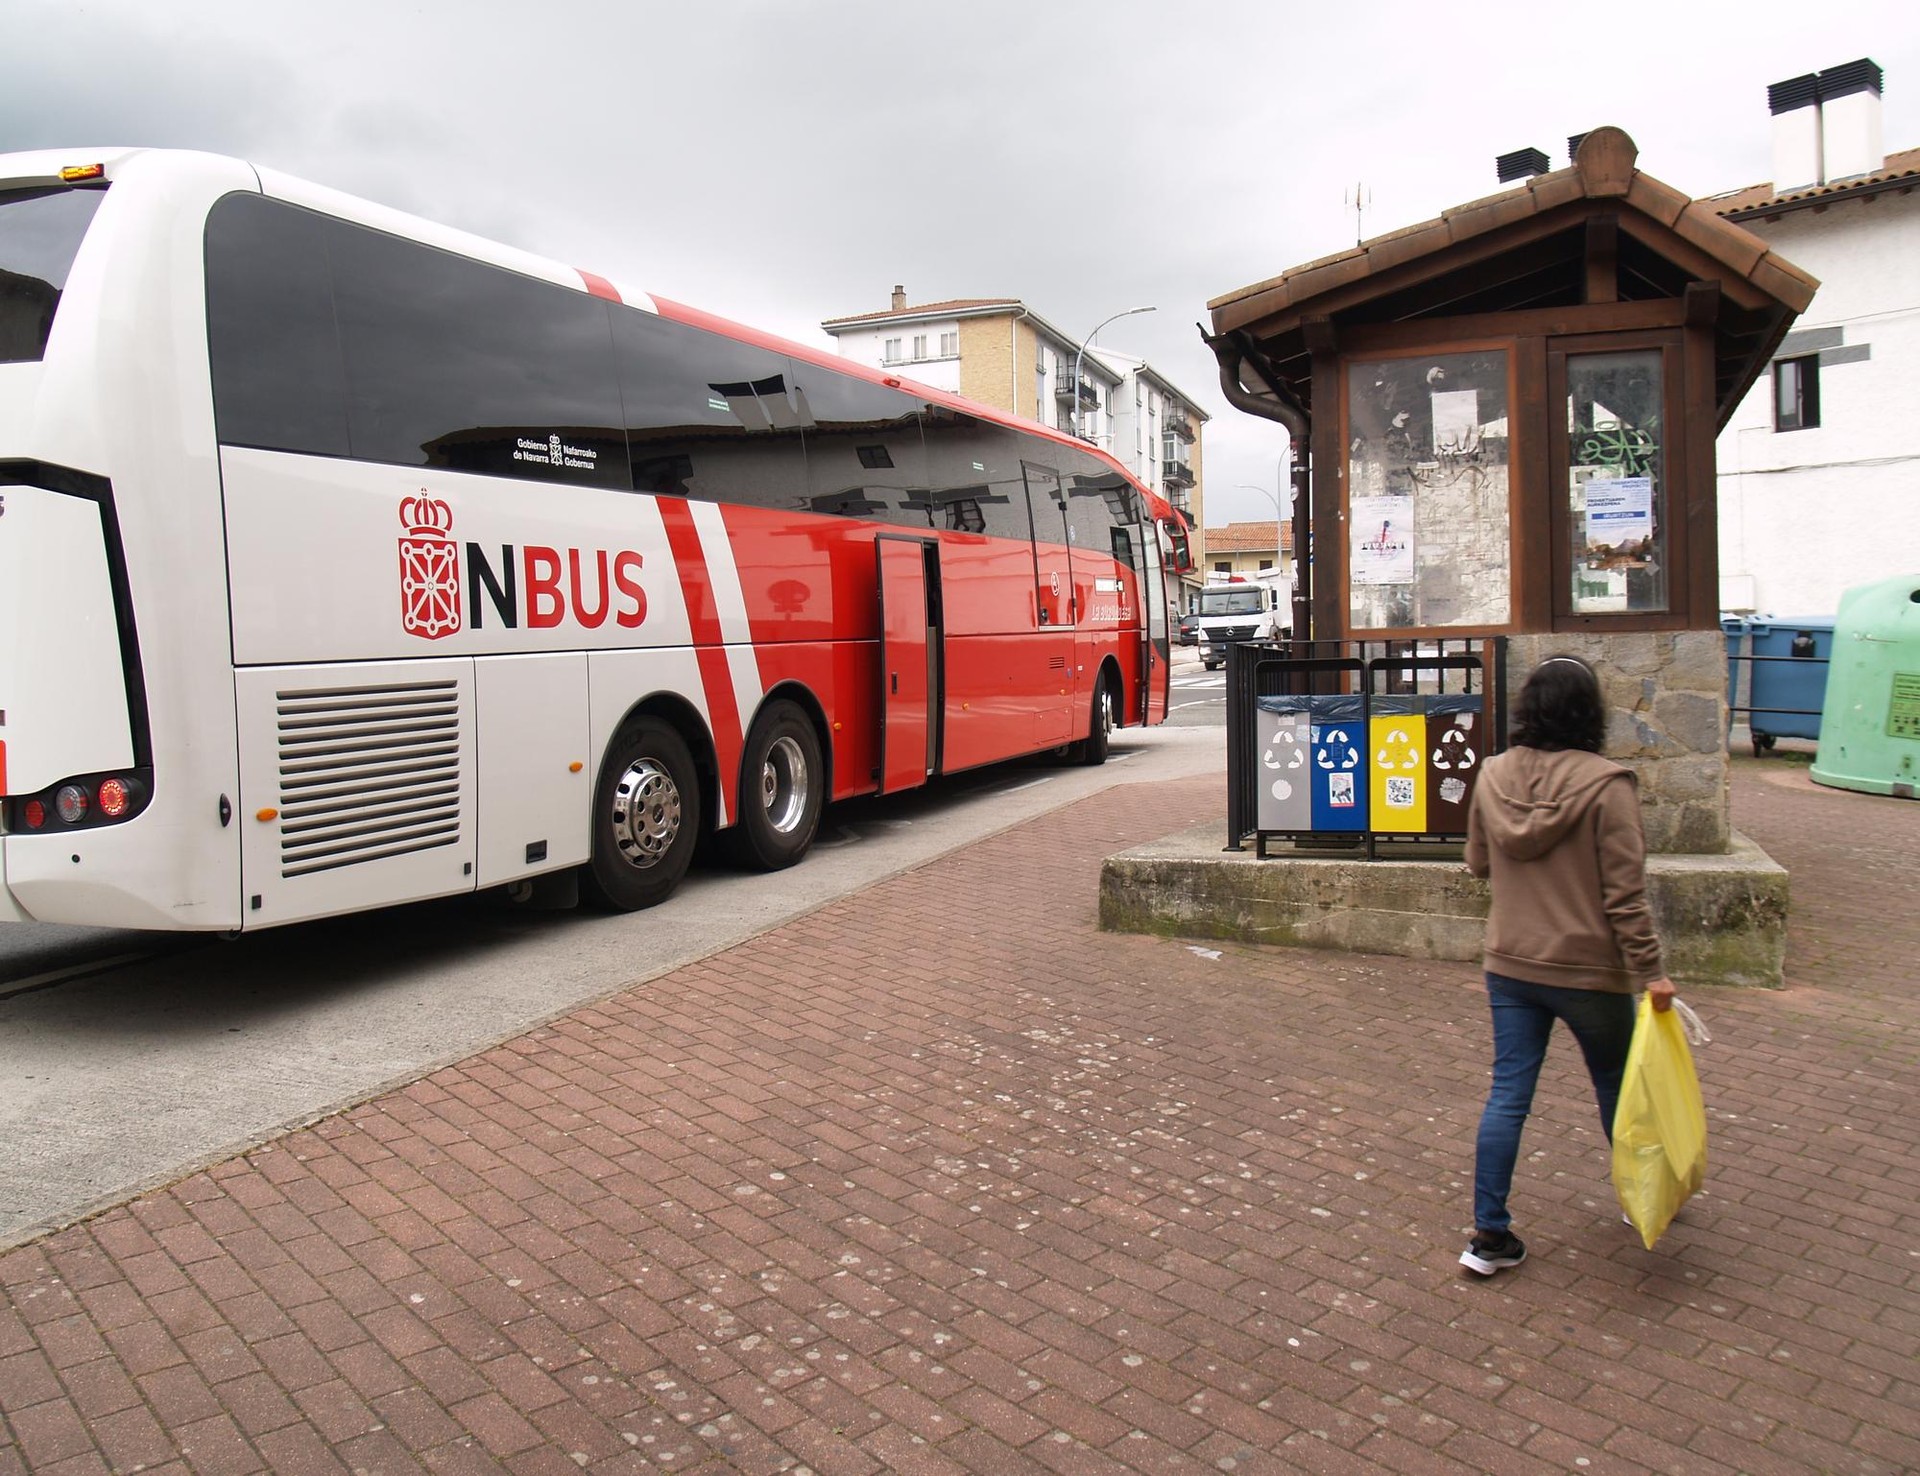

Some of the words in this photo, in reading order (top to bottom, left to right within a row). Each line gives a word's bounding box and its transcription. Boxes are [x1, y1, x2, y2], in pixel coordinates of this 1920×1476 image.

[517, 438, 548, 452] Gobierno
[563, 445, 597, 458] Nafarroako
[513, 450, 522, 460] de
[523, 451, 550, 464] Navarra
[564, 457, 595, 470] Gobernua
[466, 542, 647, 629] NBUS
